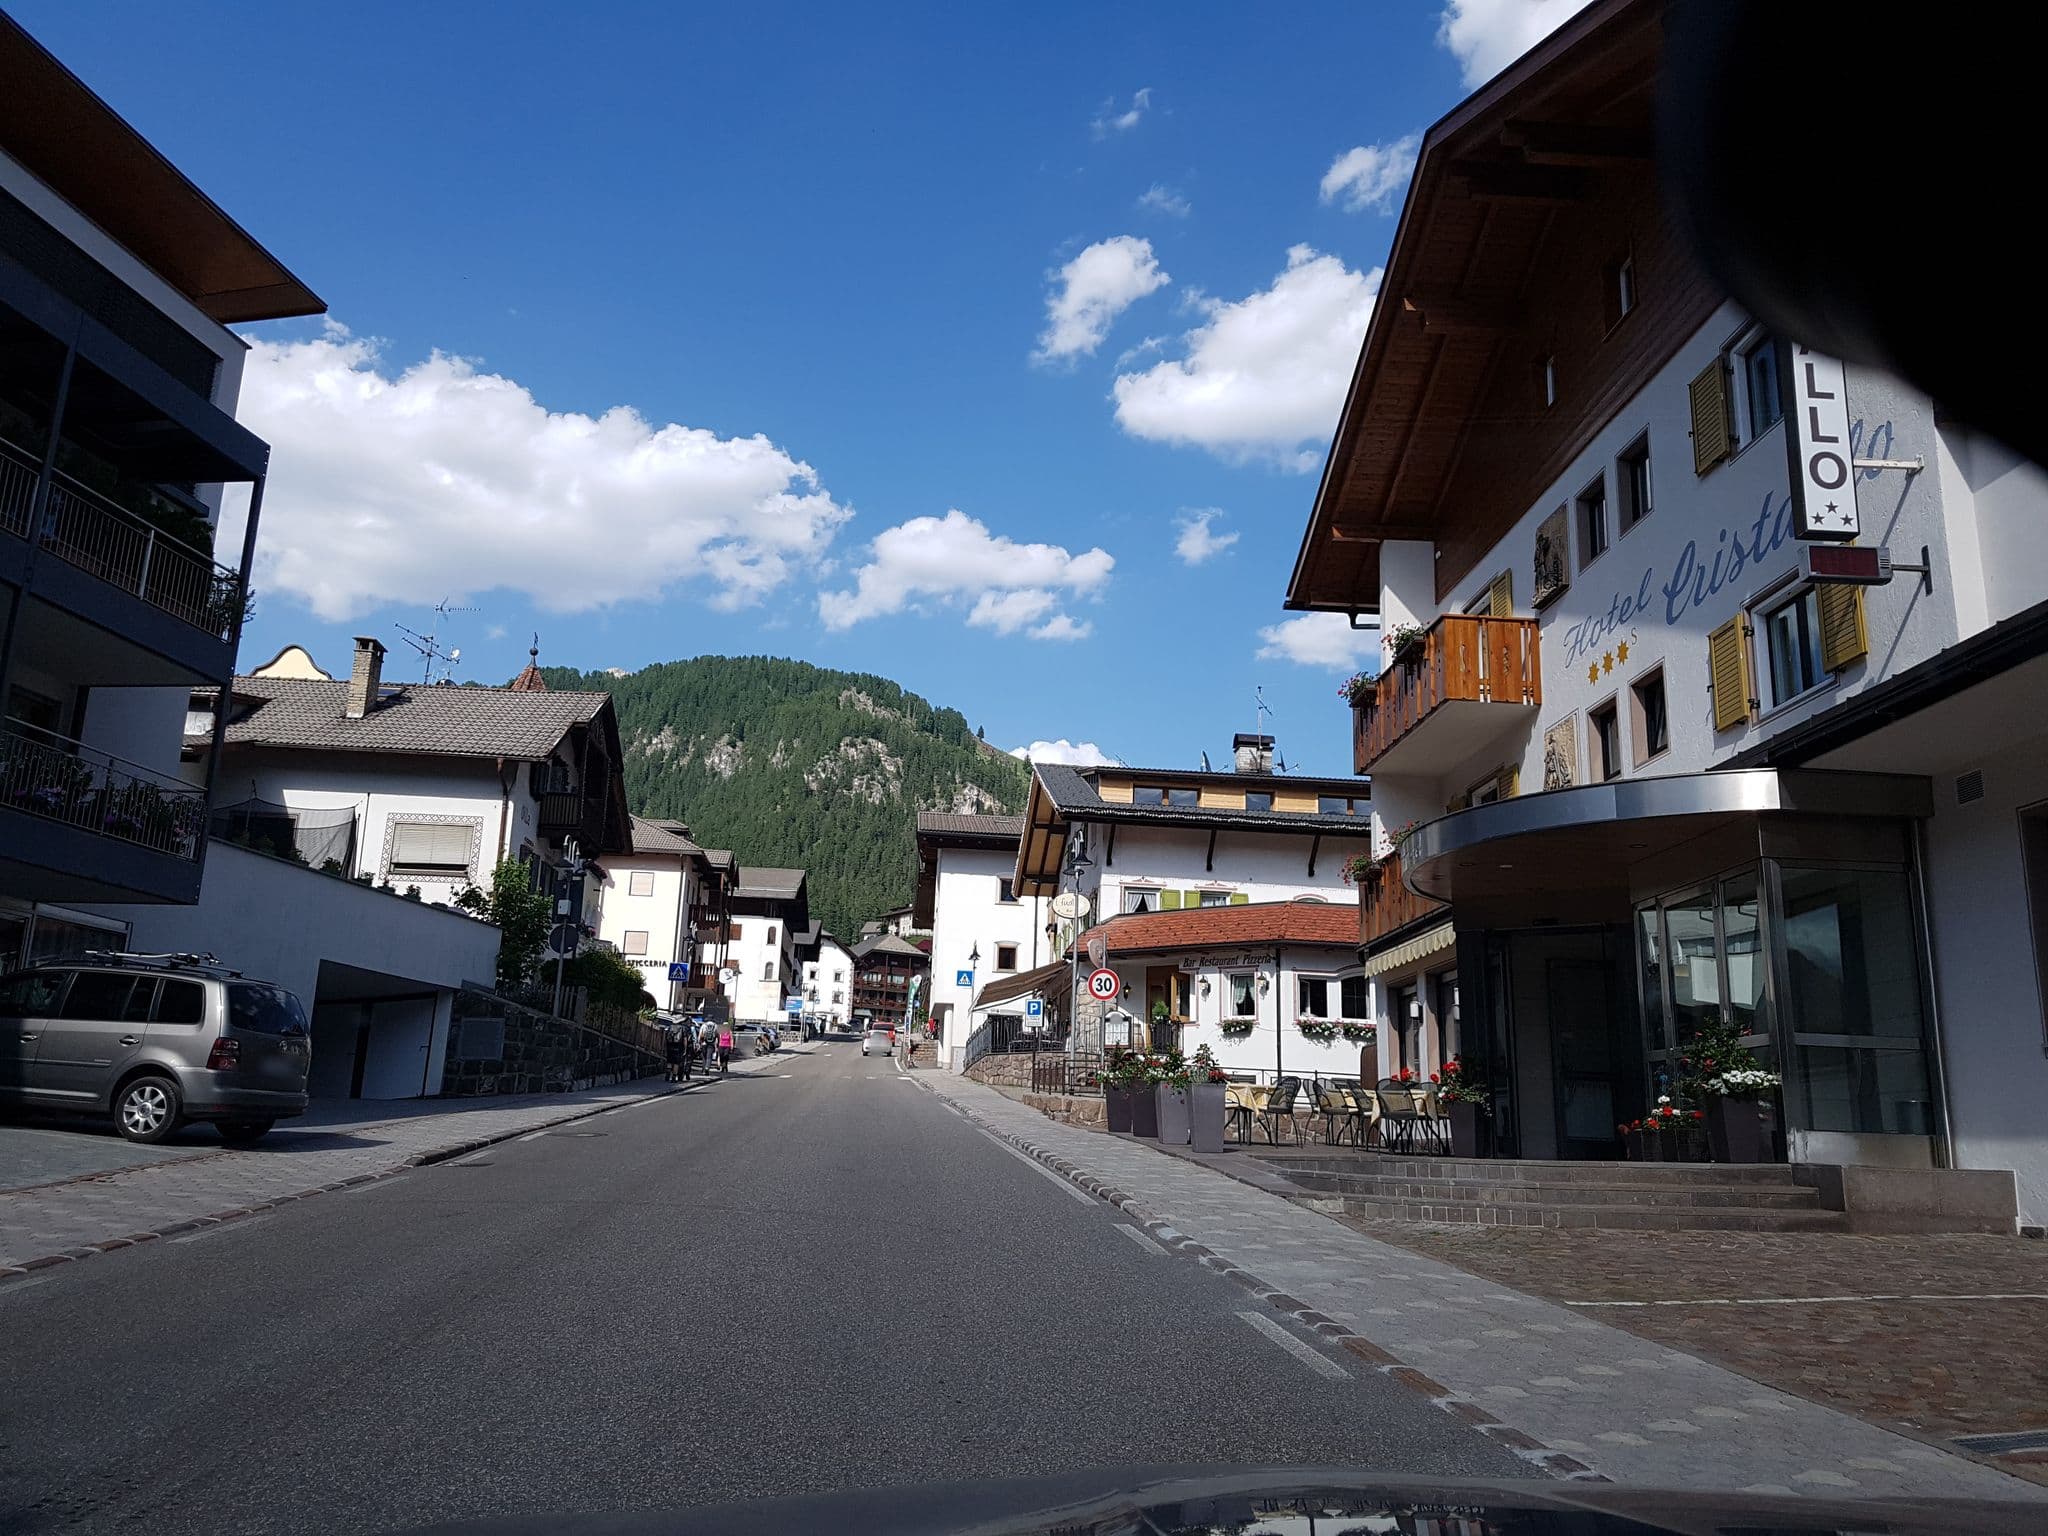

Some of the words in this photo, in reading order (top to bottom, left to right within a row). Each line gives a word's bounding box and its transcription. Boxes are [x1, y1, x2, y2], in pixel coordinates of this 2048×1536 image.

[1563, 568, 1652, 668] Hotel
[1183, 957, 1196, 967] Bar
[1199, 955, 1238, 967] Restaurant
[1243, 954, 1271, 965] Pizzeria
[1095, 978, 1112, 992] 30
[1030, 1003, 1038, 1014] P
